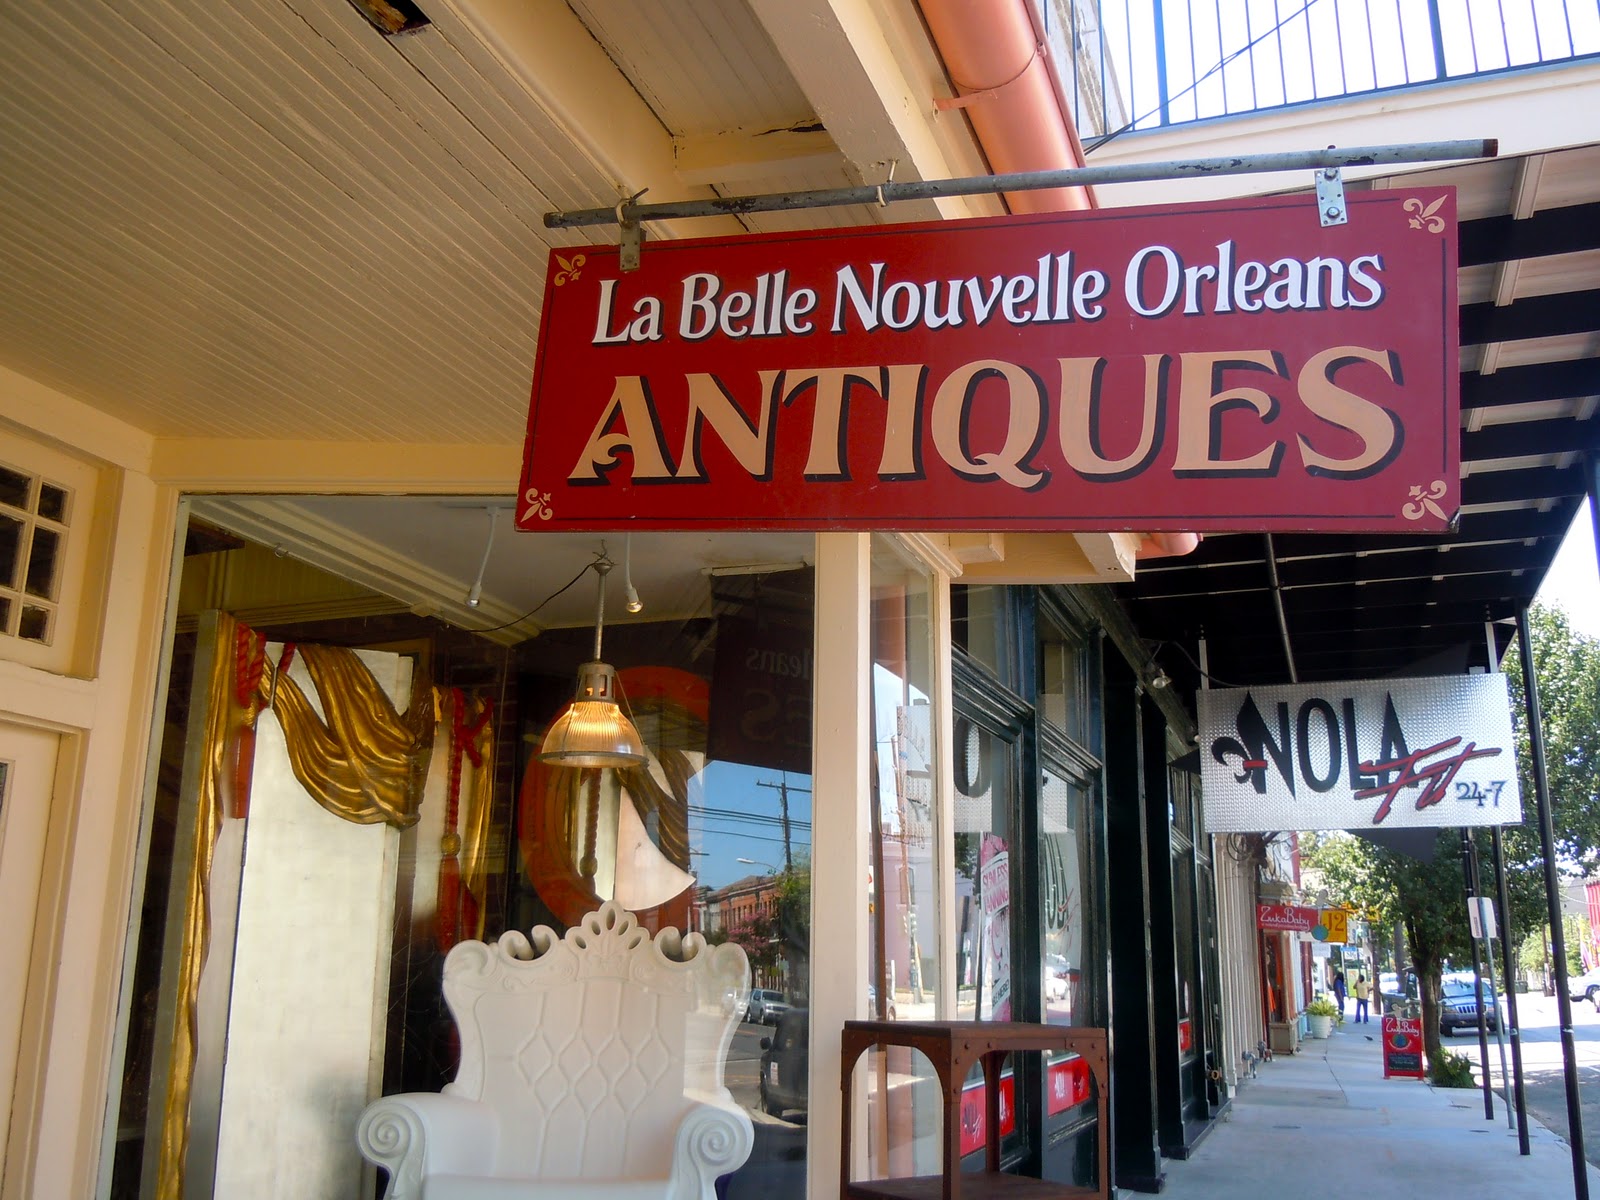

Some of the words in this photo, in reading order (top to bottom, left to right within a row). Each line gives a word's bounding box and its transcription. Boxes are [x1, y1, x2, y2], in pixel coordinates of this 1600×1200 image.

[591, 279, 663, 346] La
[678, 269, 818, 341] Belle
[830, 250, 1109, 334] Nouvelle
[1124, 239, 1385, 319] Orleans
[567, 345, 1405, 493] ANTIQUES
[1211, 690, 1419, 800] NOLA
[1455, 779, 1508, 807] 24-7
